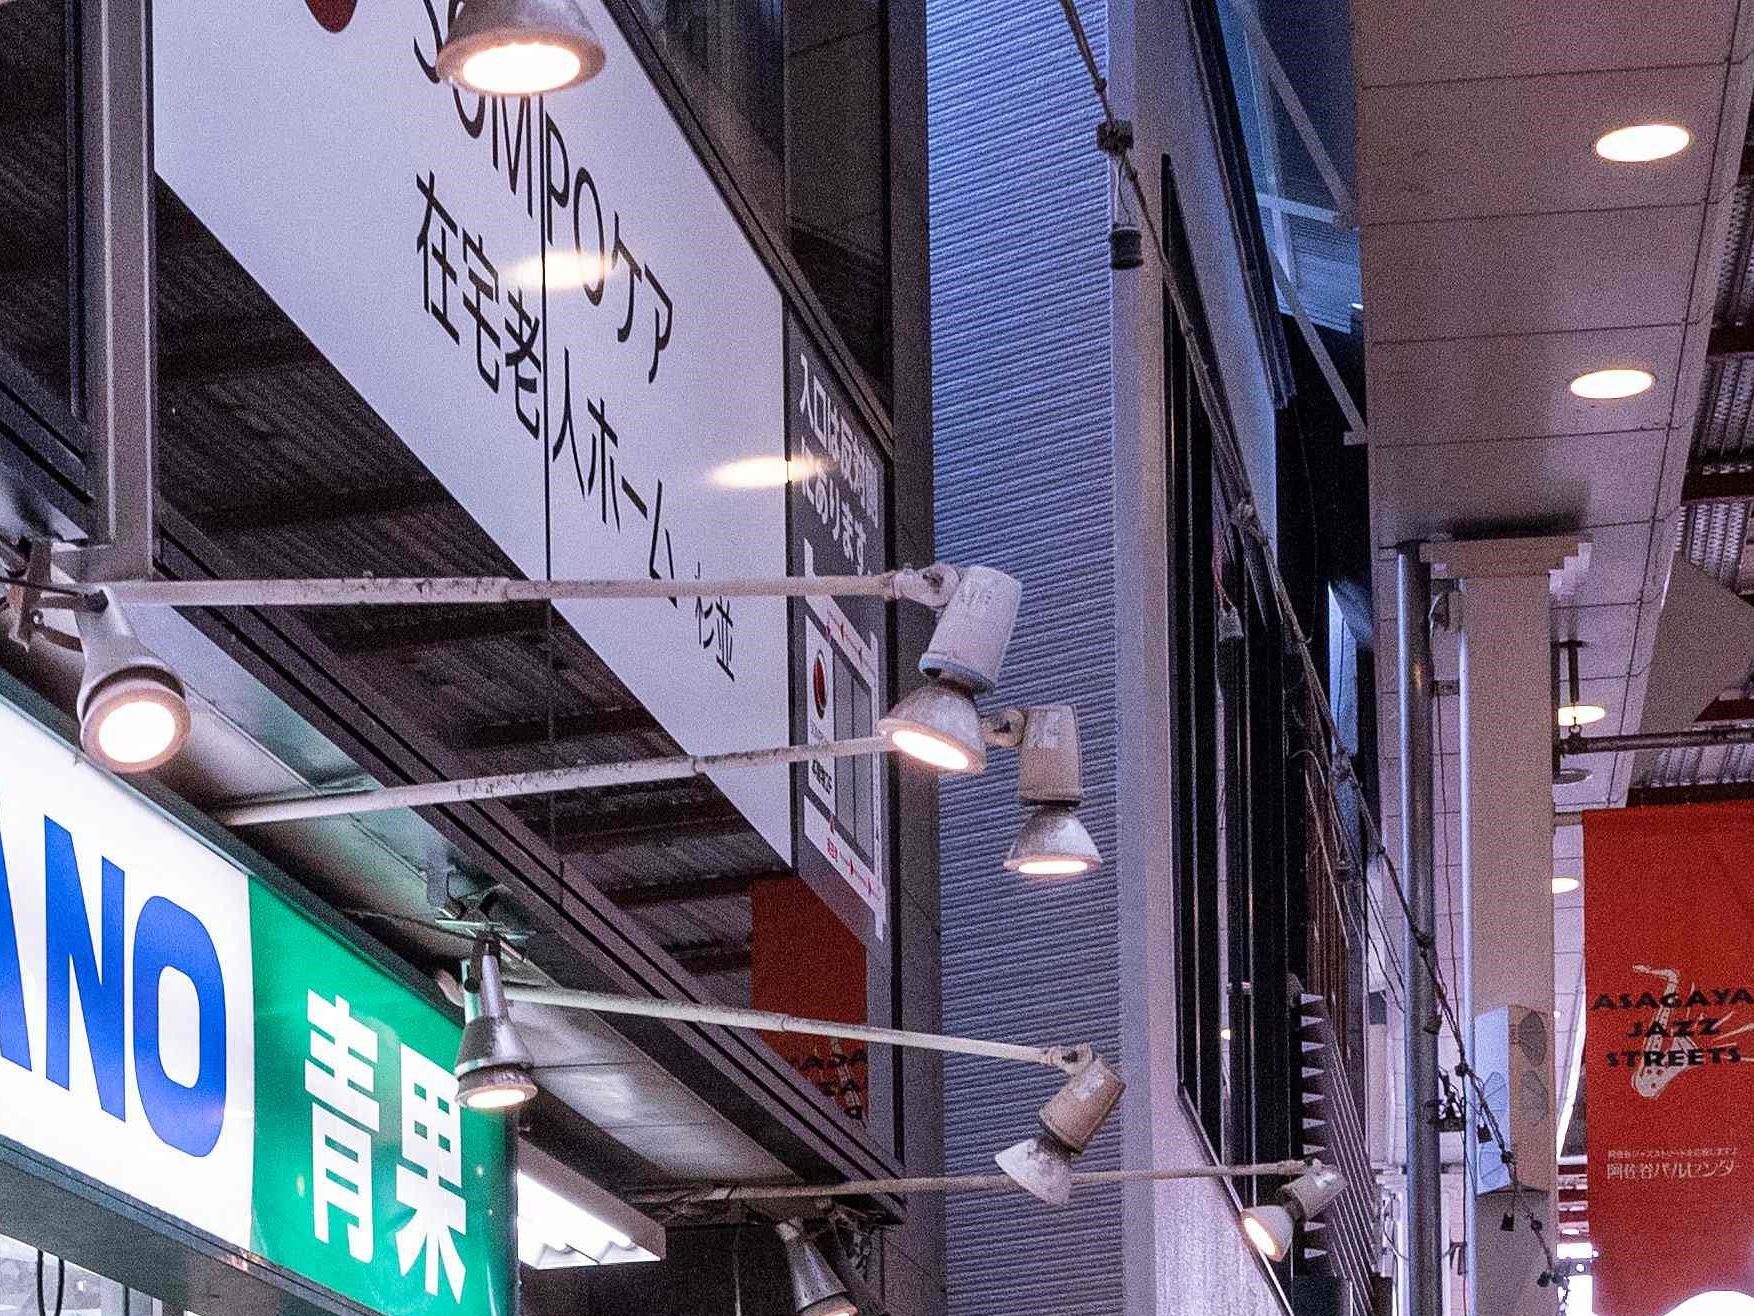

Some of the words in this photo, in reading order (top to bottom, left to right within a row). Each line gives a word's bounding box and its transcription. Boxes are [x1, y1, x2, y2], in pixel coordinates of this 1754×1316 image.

[416, 169, 678, 608] 在宅老人ホーム
[1591, 988, 1754, 1010] ASAGAYA
[1625, 1018, 1721, 1038] JAZZ
[1606, 1047, 1741, 1067] STREETS
[306, 994, 467, 1306] 青果
